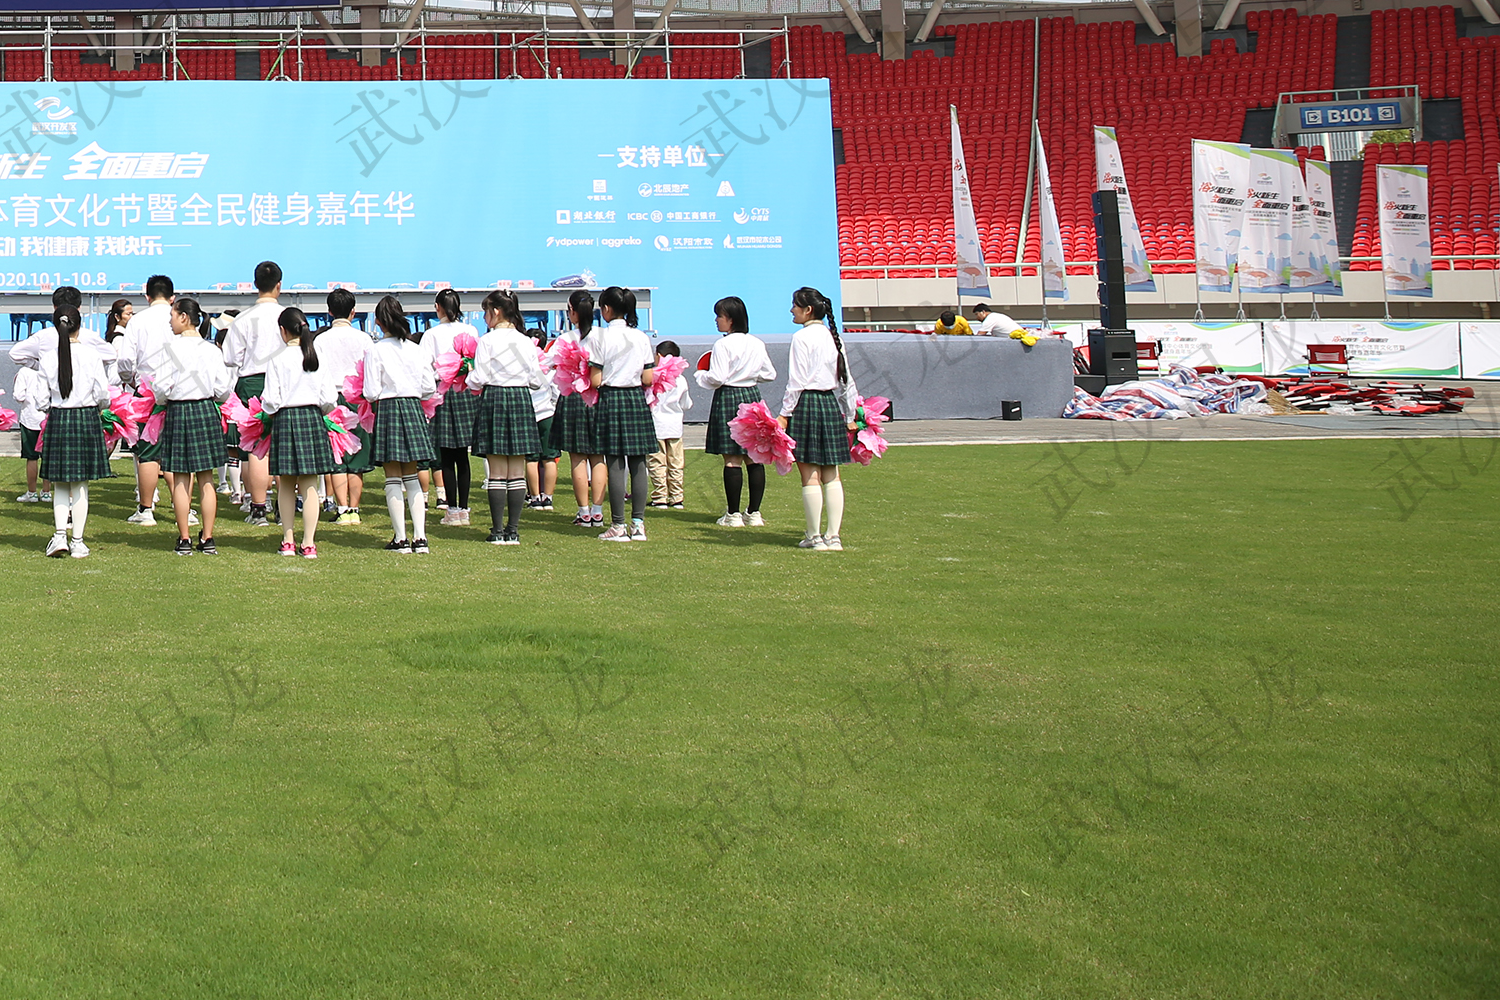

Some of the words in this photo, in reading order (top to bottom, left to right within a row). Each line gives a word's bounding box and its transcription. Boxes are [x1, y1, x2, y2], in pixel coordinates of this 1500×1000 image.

[1327, 107, 1373, 123] B101
[32, 122, 77, 131] 武汉开发区
[62, 141, 210, 180] 全面重启
[616, 145, 707, 168] 支持单位
[653, 183, 689, 193] 北辰地产
[1198, 181, 1236, 196] 浴火新生
[1210, 193, 1245, 206] 全面重启
[1252, 199, 1290, 210] 全面重启
[573, 210, 616, 221] 湖北银行
[627, 212, 649, 221] ICBC
[666, 211, 717, 220] 中国工商银行
[750, 207, 770, 215] CYTS
[20, 236, 90, 257] 我健康
[93, 235, 163, 256] 我快乐
[555, 237, 594, 247] ydpower
[601, 236, 642, 248] aggreko
[673, 237, 713, 246] 汉阳市政
